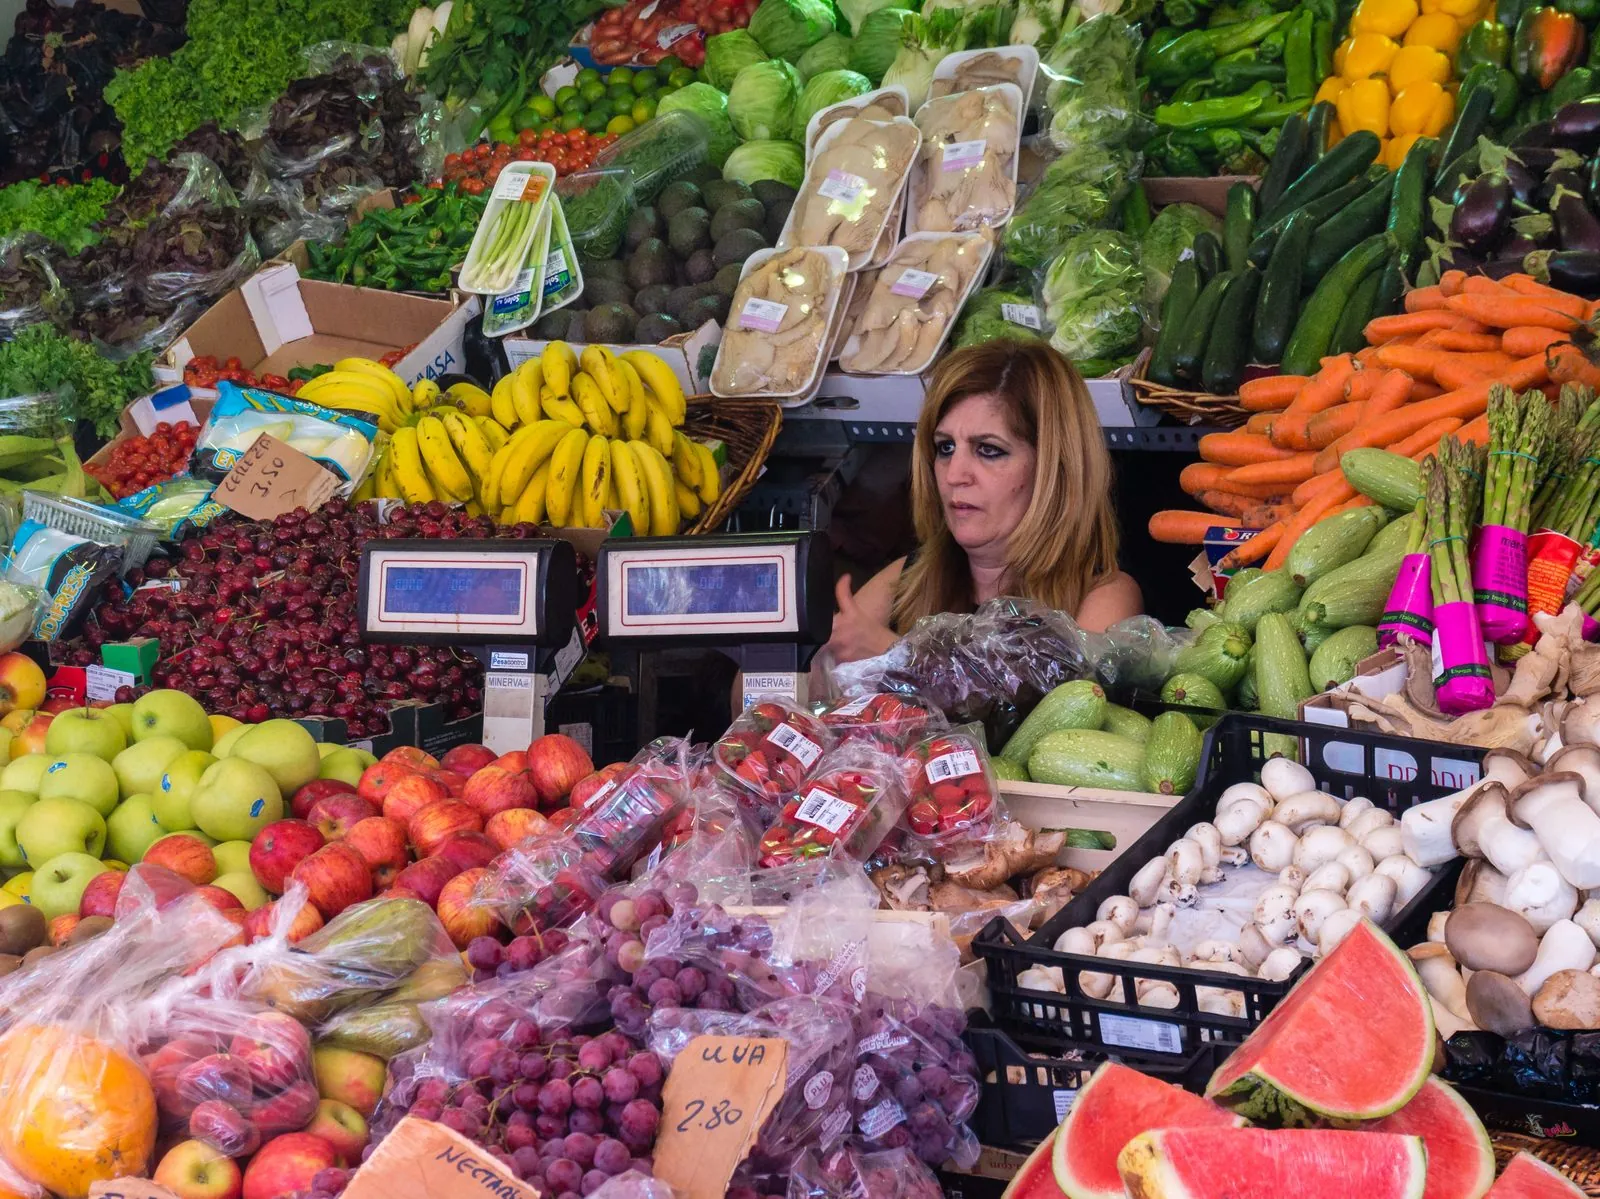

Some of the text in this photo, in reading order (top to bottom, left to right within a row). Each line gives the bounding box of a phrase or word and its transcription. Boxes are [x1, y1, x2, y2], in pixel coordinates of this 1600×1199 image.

[250, 457, 284, 497] 3.50
[492, 657, 526, 667] Pesacontrol
[489, 677, 523, 687] MINERVA
[745, 678, 784, 687] MINERVA
[810, 1077, 828, 1097] PLU
[676, 1099, 743, 1132] 2.80
